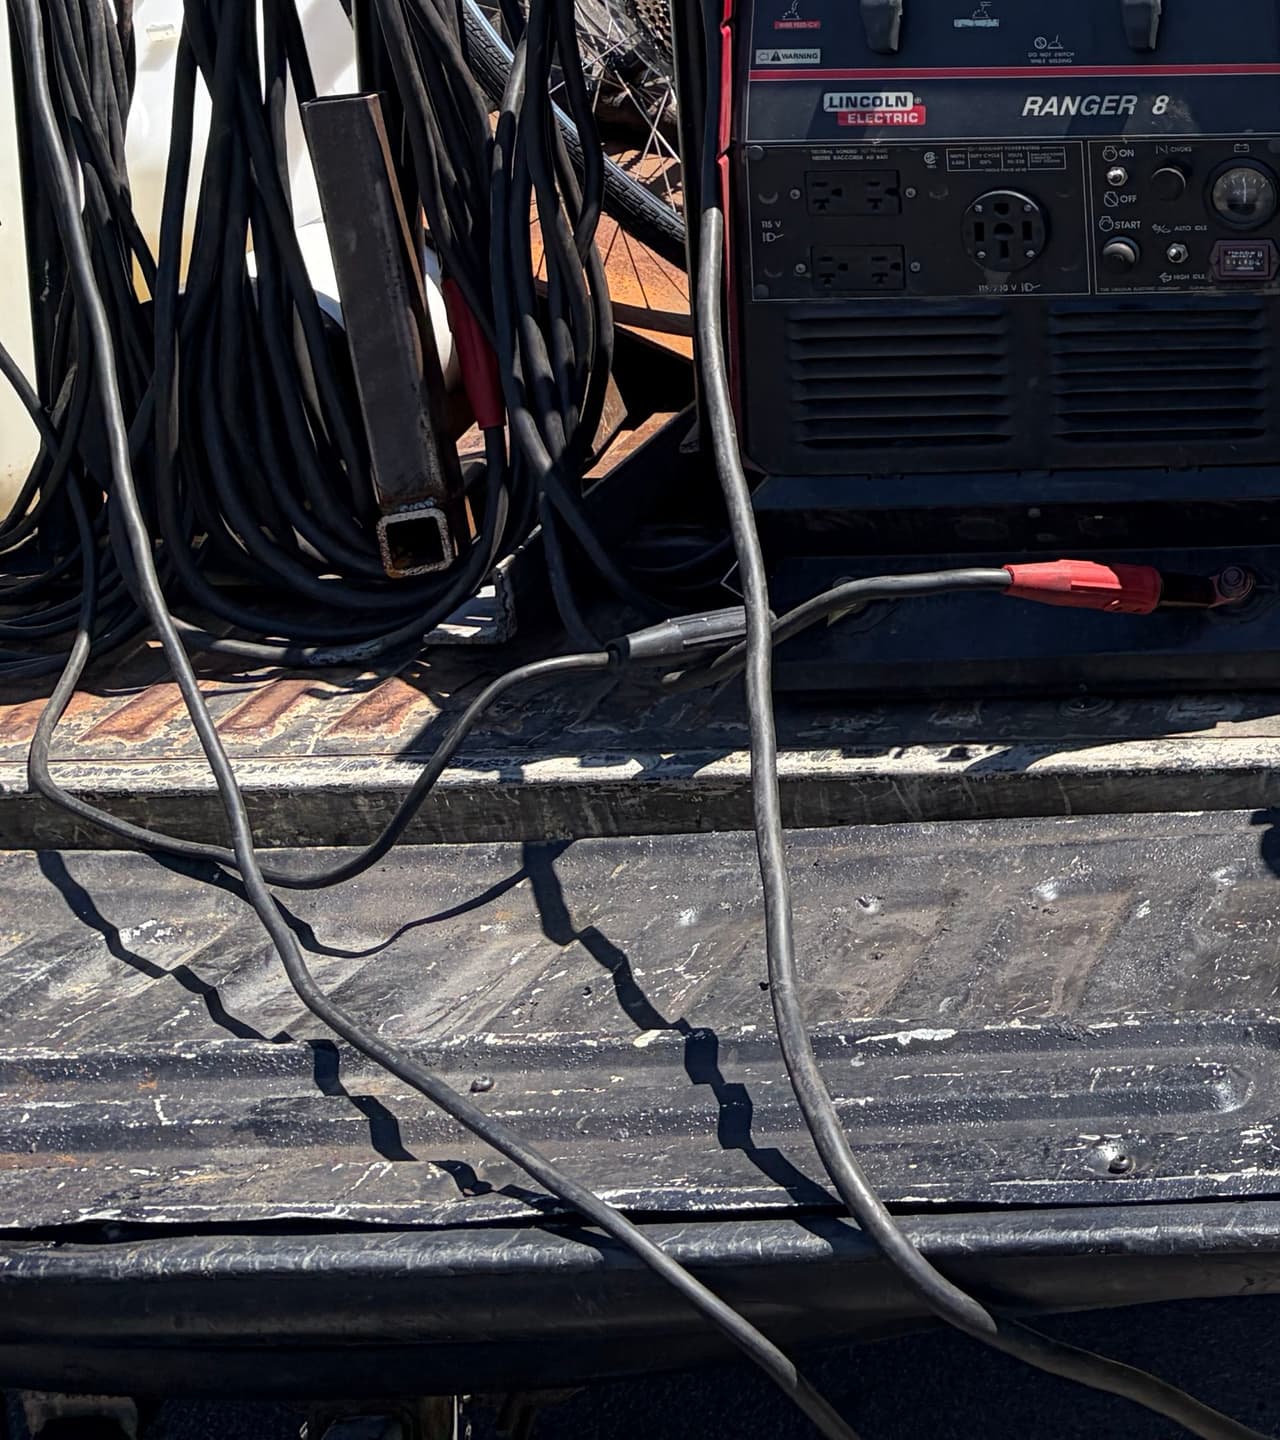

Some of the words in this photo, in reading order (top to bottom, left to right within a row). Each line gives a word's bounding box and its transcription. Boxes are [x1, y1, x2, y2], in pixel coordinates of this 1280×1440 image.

[826, 95, 909, 109] LINCOLN
[1022, 95, 1138, 116] RANGER
[1152, 95, 1170, 115] 8
[847, 112, 919, 123] ELECTRIC
[1119, 149, 1134, 157] ON
[1119, 195, 1137, 203] OFF
[1114, 221, 1141, 229] START
